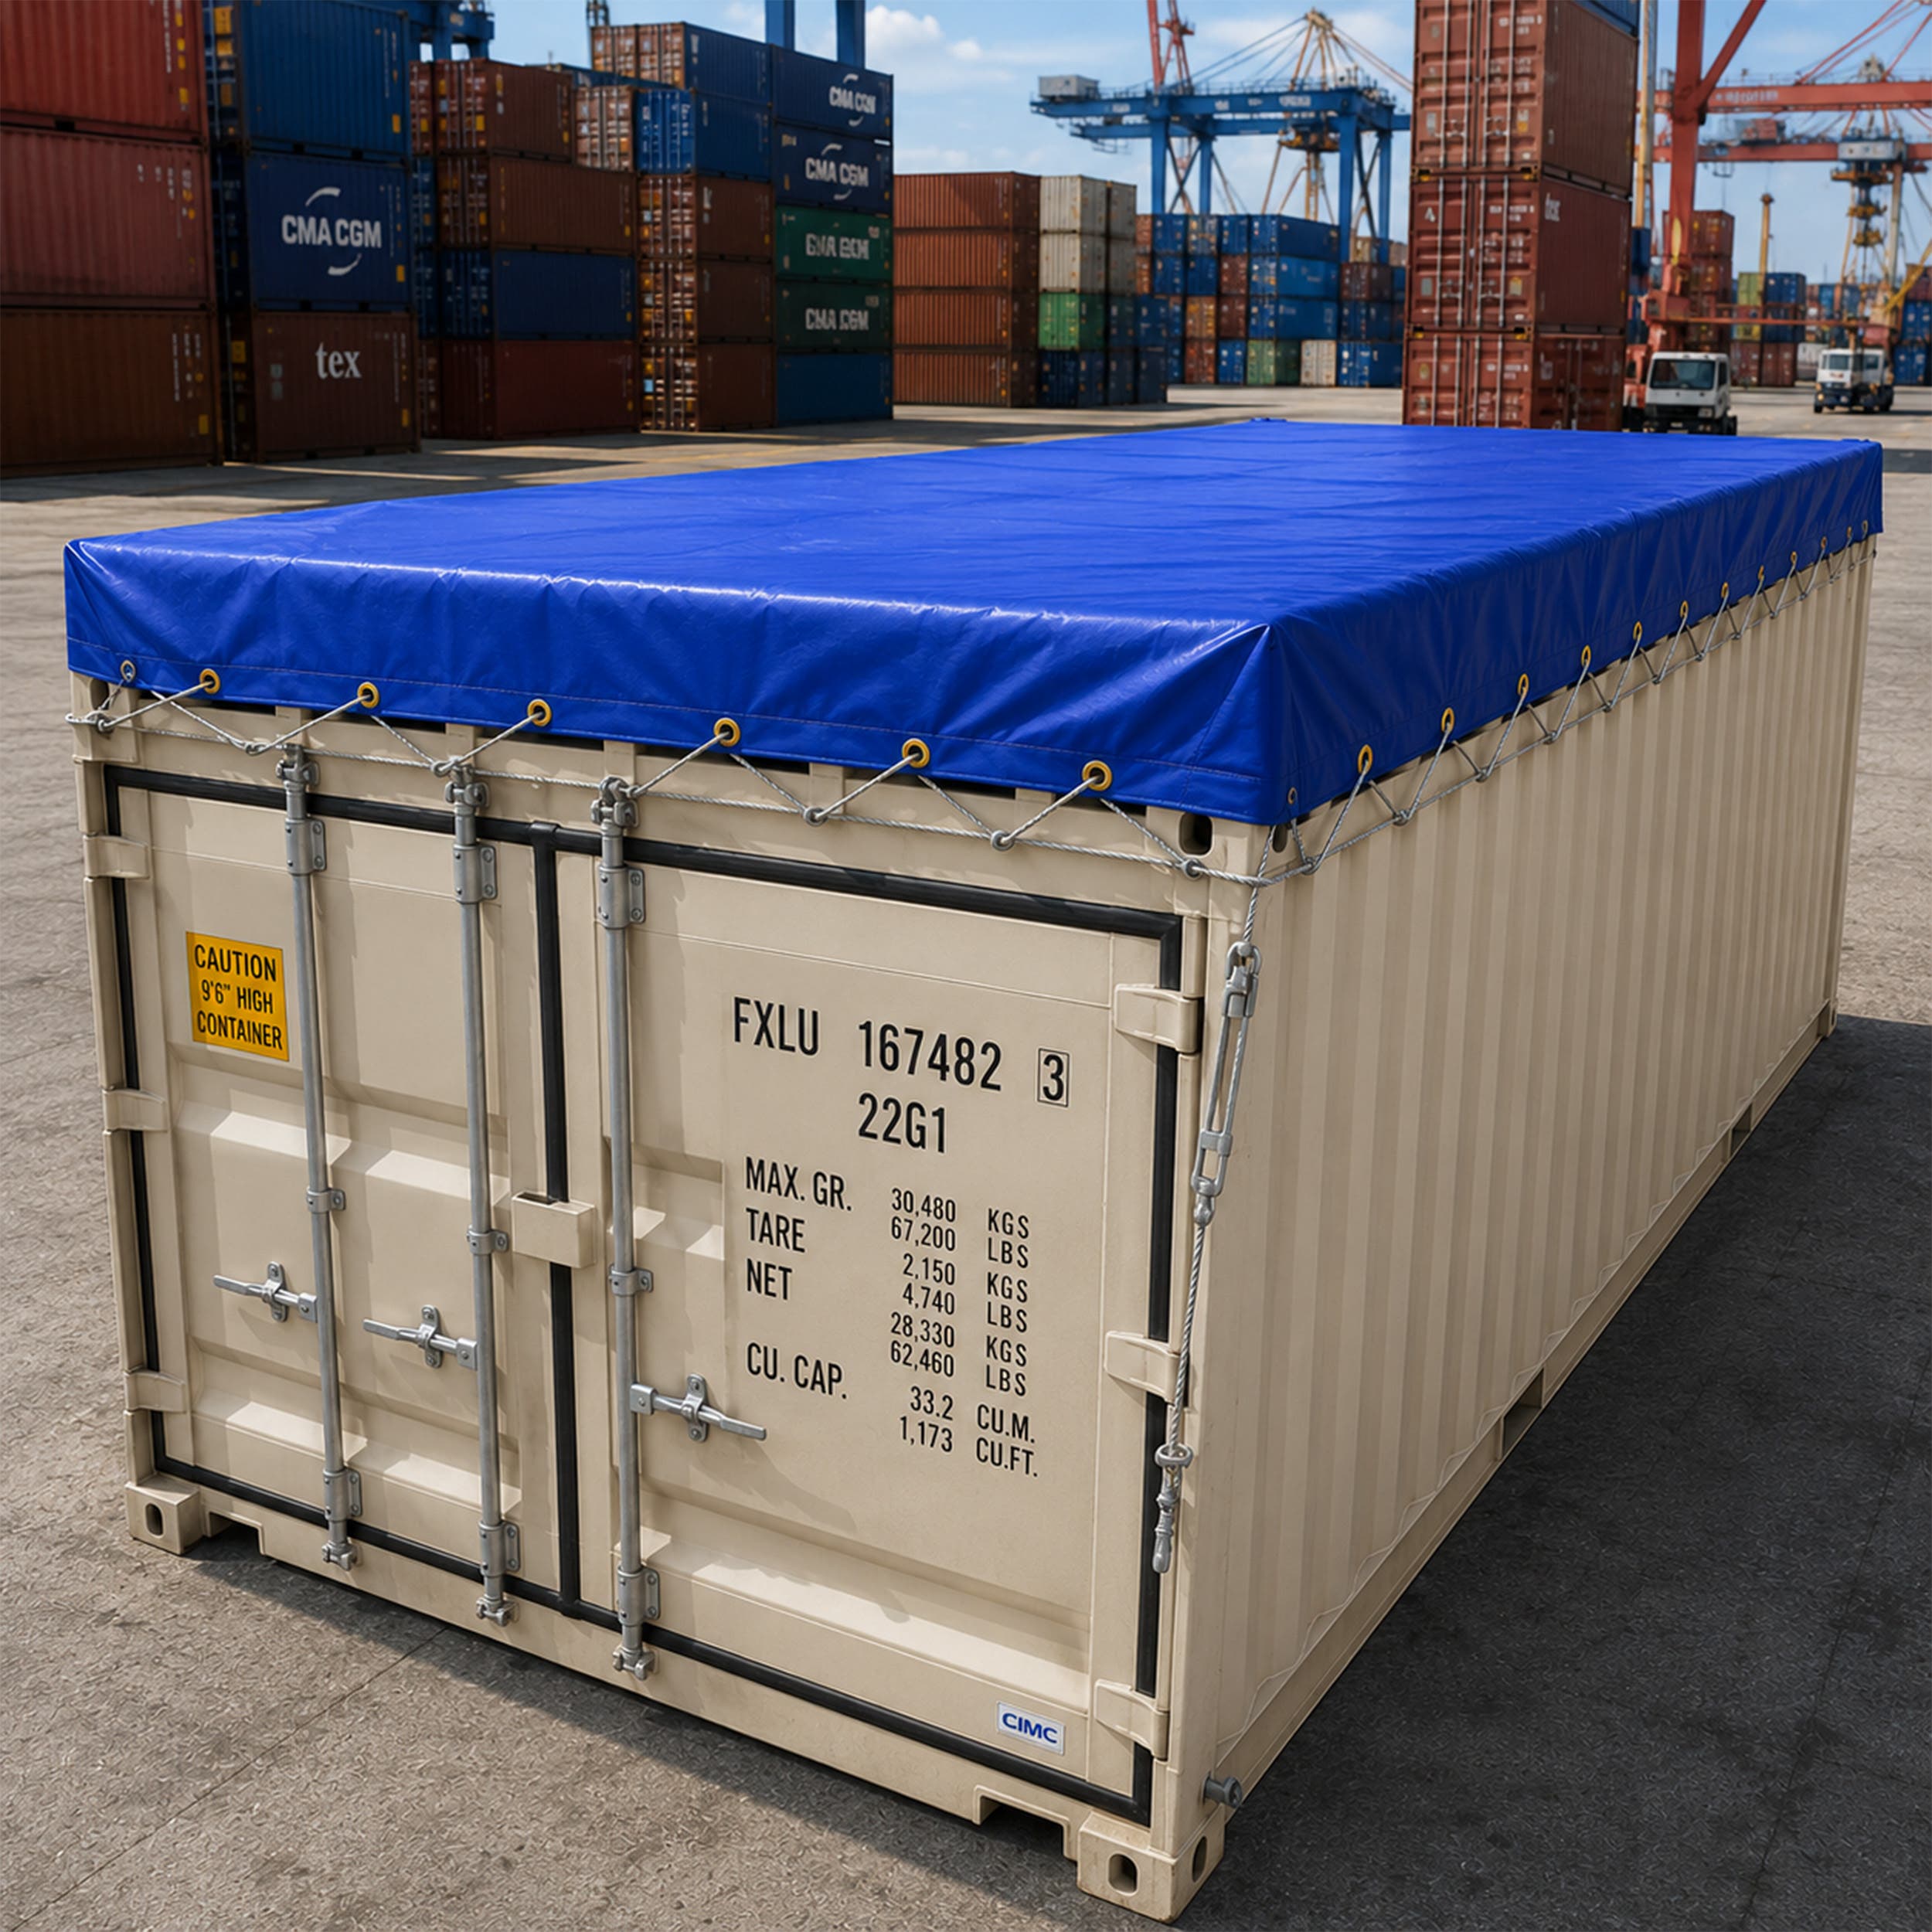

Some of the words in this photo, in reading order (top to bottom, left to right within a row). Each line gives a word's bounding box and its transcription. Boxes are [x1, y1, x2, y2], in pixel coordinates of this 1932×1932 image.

[281, 214, 332, 247] CMA
[335, 218, 383, 249] CGM
[315, 342, 362, 379] tex
[194, 944, 277, 982] CAUTION
[236, 986, 274, 1015] HIGH
[196, 1010, 283, 1050] CONTAINER
[734, 996, 819, 1056] FXLU
[859, 1020, 1002, 1091] 167482
[1043, 1054, 1065, 1101] 3
[859, 1092, 945, 1154] 22G1
[746, 1156, 805, 1202] MAX.
[813, 1171, 852, 1212] GR.
[891, 1188, 956, 1223] 30,480
[988, 1208, 1029, 1240] KGS
[746, 1207, 805, 1253] TARE
[891, 1216, 956, 1251] 67,200
[988, 1237, 1029, 1269] LBS
[747, 1258, 793, 1301] NET
[903, 1253, 955, 1286] 2,150
[987, 1271, 1028, 1303] KGS
[903, 1283, 955, 1315] 4,740
[987, 1301, 1028, 1333] LBS
[890, 1311, 954, 1348] 28,330
[986, 1335, 1027, 1367] KGS
[747, 1342, 786, 1383] CU.
[794, 1355, 847, 1400] CAP.
[890, 1340, 954, 1377] 62,460
[986, 1365, 1026, 1396] LBS
[910, 1386, 953, 1421] 33.2
[900, 1415, 953, 1453] 1,173
[1002, 1713, 1058, 1744] CIMC
